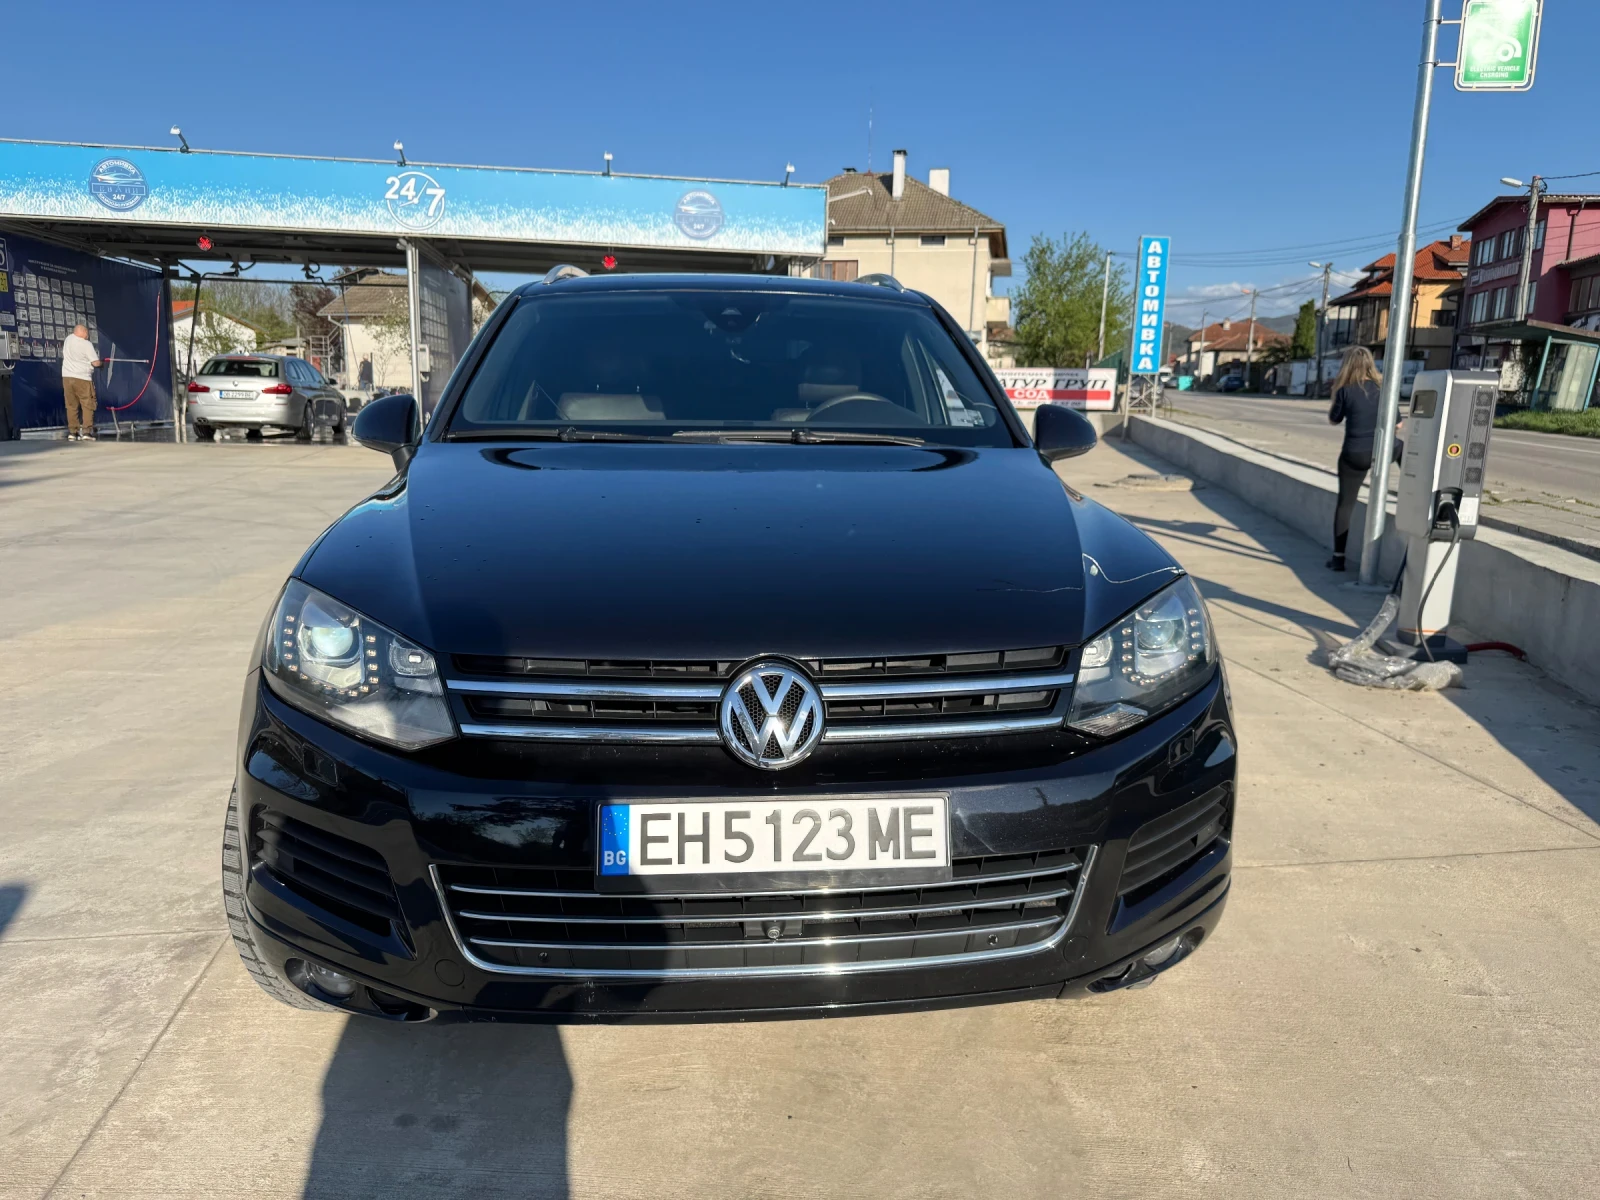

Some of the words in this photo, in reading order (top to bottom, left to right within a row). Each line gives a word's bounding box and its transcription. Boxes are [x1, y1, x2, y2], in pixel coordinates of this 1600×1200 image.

[98, 160, 137, 175] АВТОМИВКА
[112, 193, 126, 201] 24/7
[1137, 240, 1163, 370] АВТОМИВКА
[1053, 379, 1108, 390] ГРУП
[1013, 389, 1051, 400] СОД
[604, 850, 626, 866] BG
